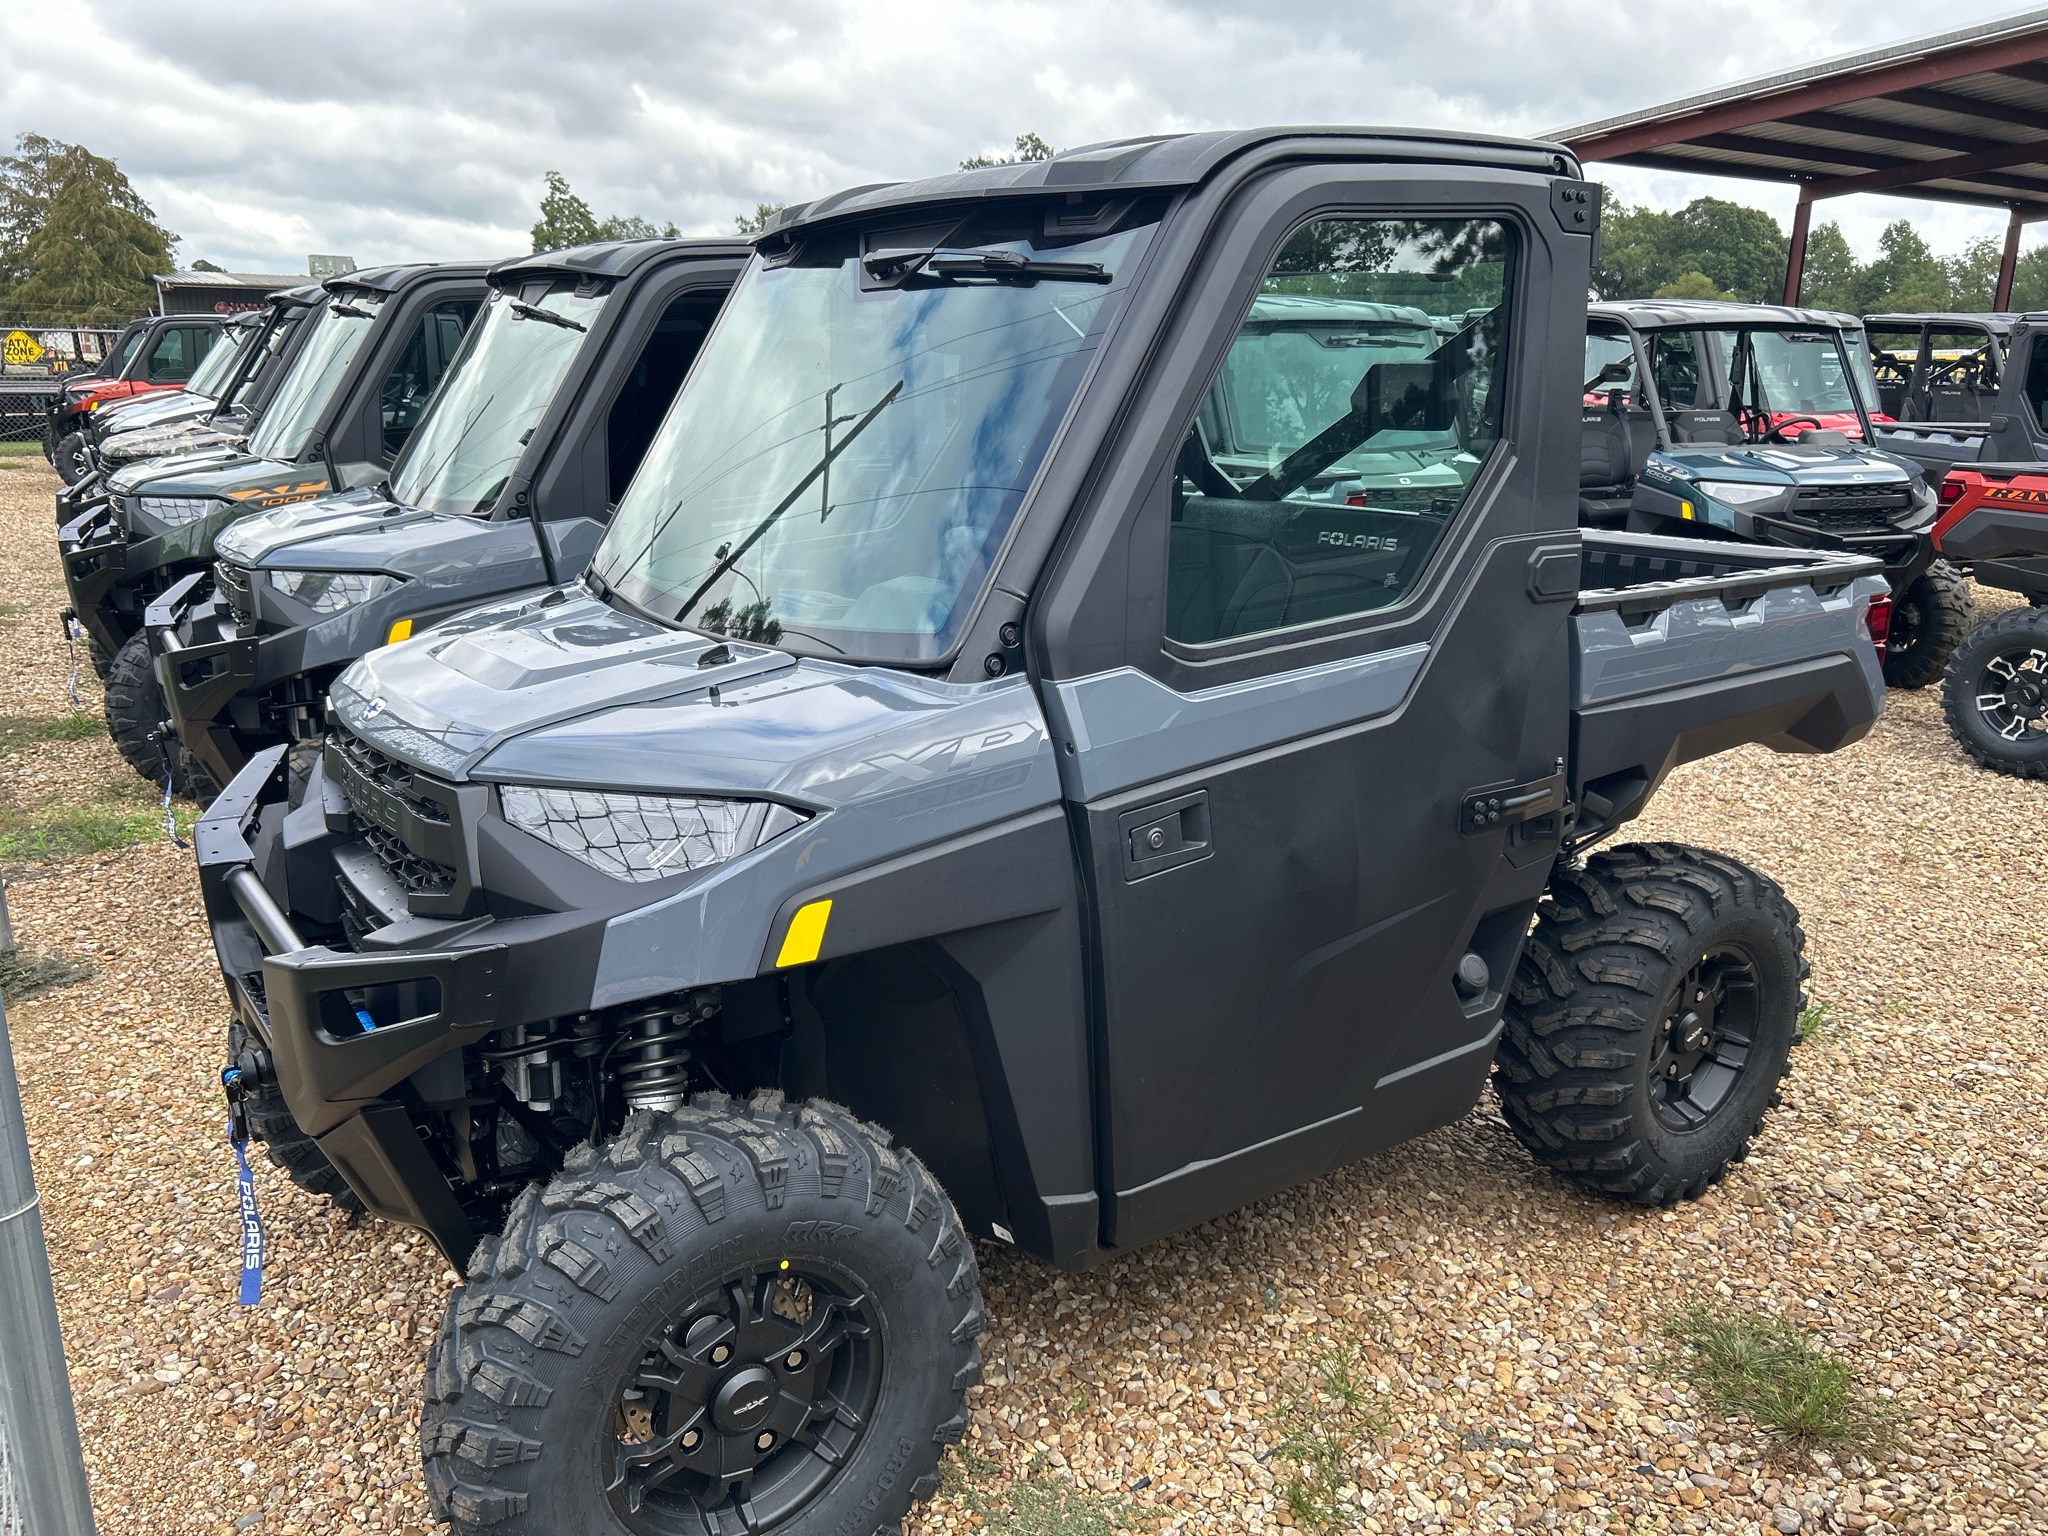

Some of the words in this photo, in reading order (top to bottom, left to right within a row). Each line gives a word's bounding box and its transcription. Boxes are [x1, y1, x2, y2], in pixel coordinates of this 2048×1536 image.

[6, 348, 35, 356] ZONE
[8, 339, 28, 348] ATV
[195, 413, 212, 423] X
[1646, 468, 1673, 482] 1000
[1650, 459, 1689, 476] XP
[261, 494, 318, 507] 1000
[1318, 531, 1398, 552] POLARIS
[423, 541, 532, 575] XP
[852, 720, 1037, 797] XP
[892, 766, 1024, 817] 1000
[240, 1180, 260, 1270] POLARIS
[579, 1233, 744, 1392] X-TERRAIN
[876, 1437, 917, 1491] PRO
